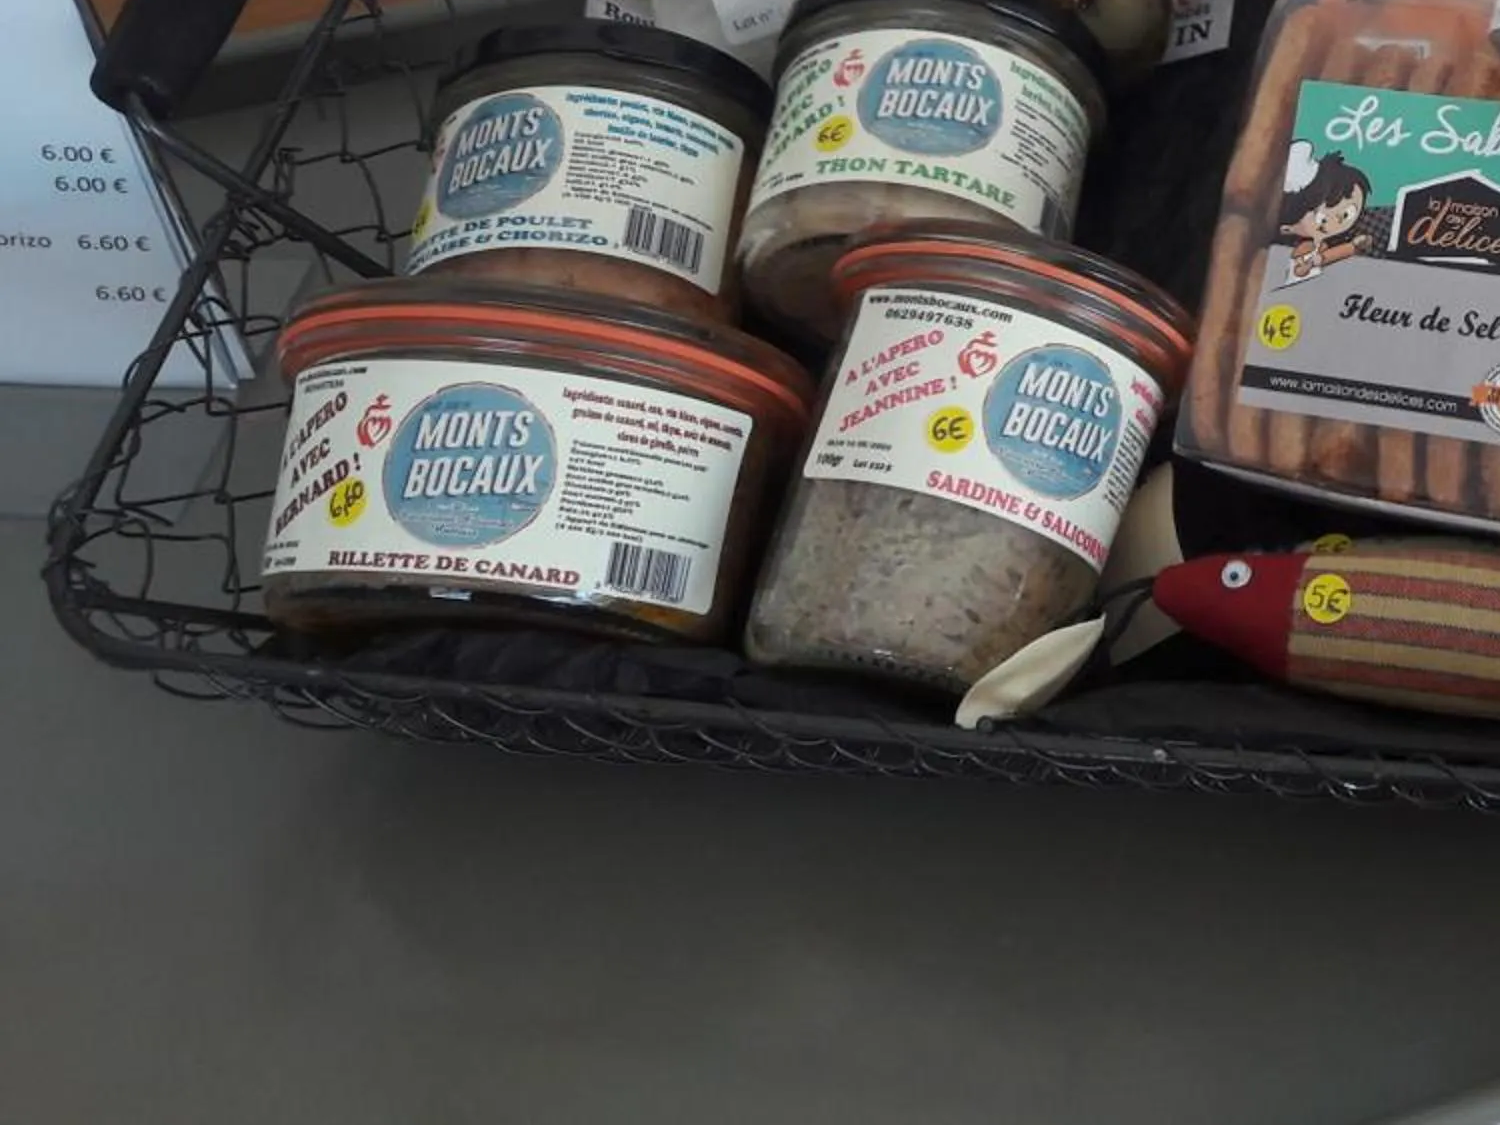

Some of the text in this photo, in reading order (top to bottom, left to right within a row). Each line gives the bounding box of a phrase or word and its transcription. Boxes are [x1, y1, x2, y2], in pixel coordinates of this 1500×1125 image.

[886, 57, 986, 90] MONTS
[878, 89, 997, 126] BOCAUX
[1325, 95, 1411, 151] Les
[455, 107, 544, 159] MONTS
[41, 144, 116, 164] 6.00 €
[448, 138, 552, 195] BOCAUX
[55, 176, 129, 194] 6.00 €
[815, 158, 1017, 210] THON TARTARE
[77, 234, 129, 251] 6.60
[135, 236, 152, 252] €
[464, 215, 592, 233] DE POULET
[497, 230, 608, 246] CHORIZO
[95, 285, 167, 303] 6.60 €
[1338, 293, 1413, 328] Fleur
[1418, 306, 1450, 331] de
[1263, 314, 1296, 343] 4€
[861, 329, 944, 374] L'APERO
[865, 362, 921, 396] AVEC
[1017, 362, 1114, 418] MONTS
[839, 378, 946, 432] JEANNINE
[415, 410, 534, 450] MONTS
[1003, 403, 1113, 463] BOCAUX
[291, 438, 331, 488] AVEC
[403, 454, 543, 498] BOCAUX
[275, 459, 350, 537] BERNARD
[926, 470, 1021, 513] SARDINE
[328, 550, 581, 586] RILLETTE DE CANARD
[1309, 584, 1347, 613] 5€
